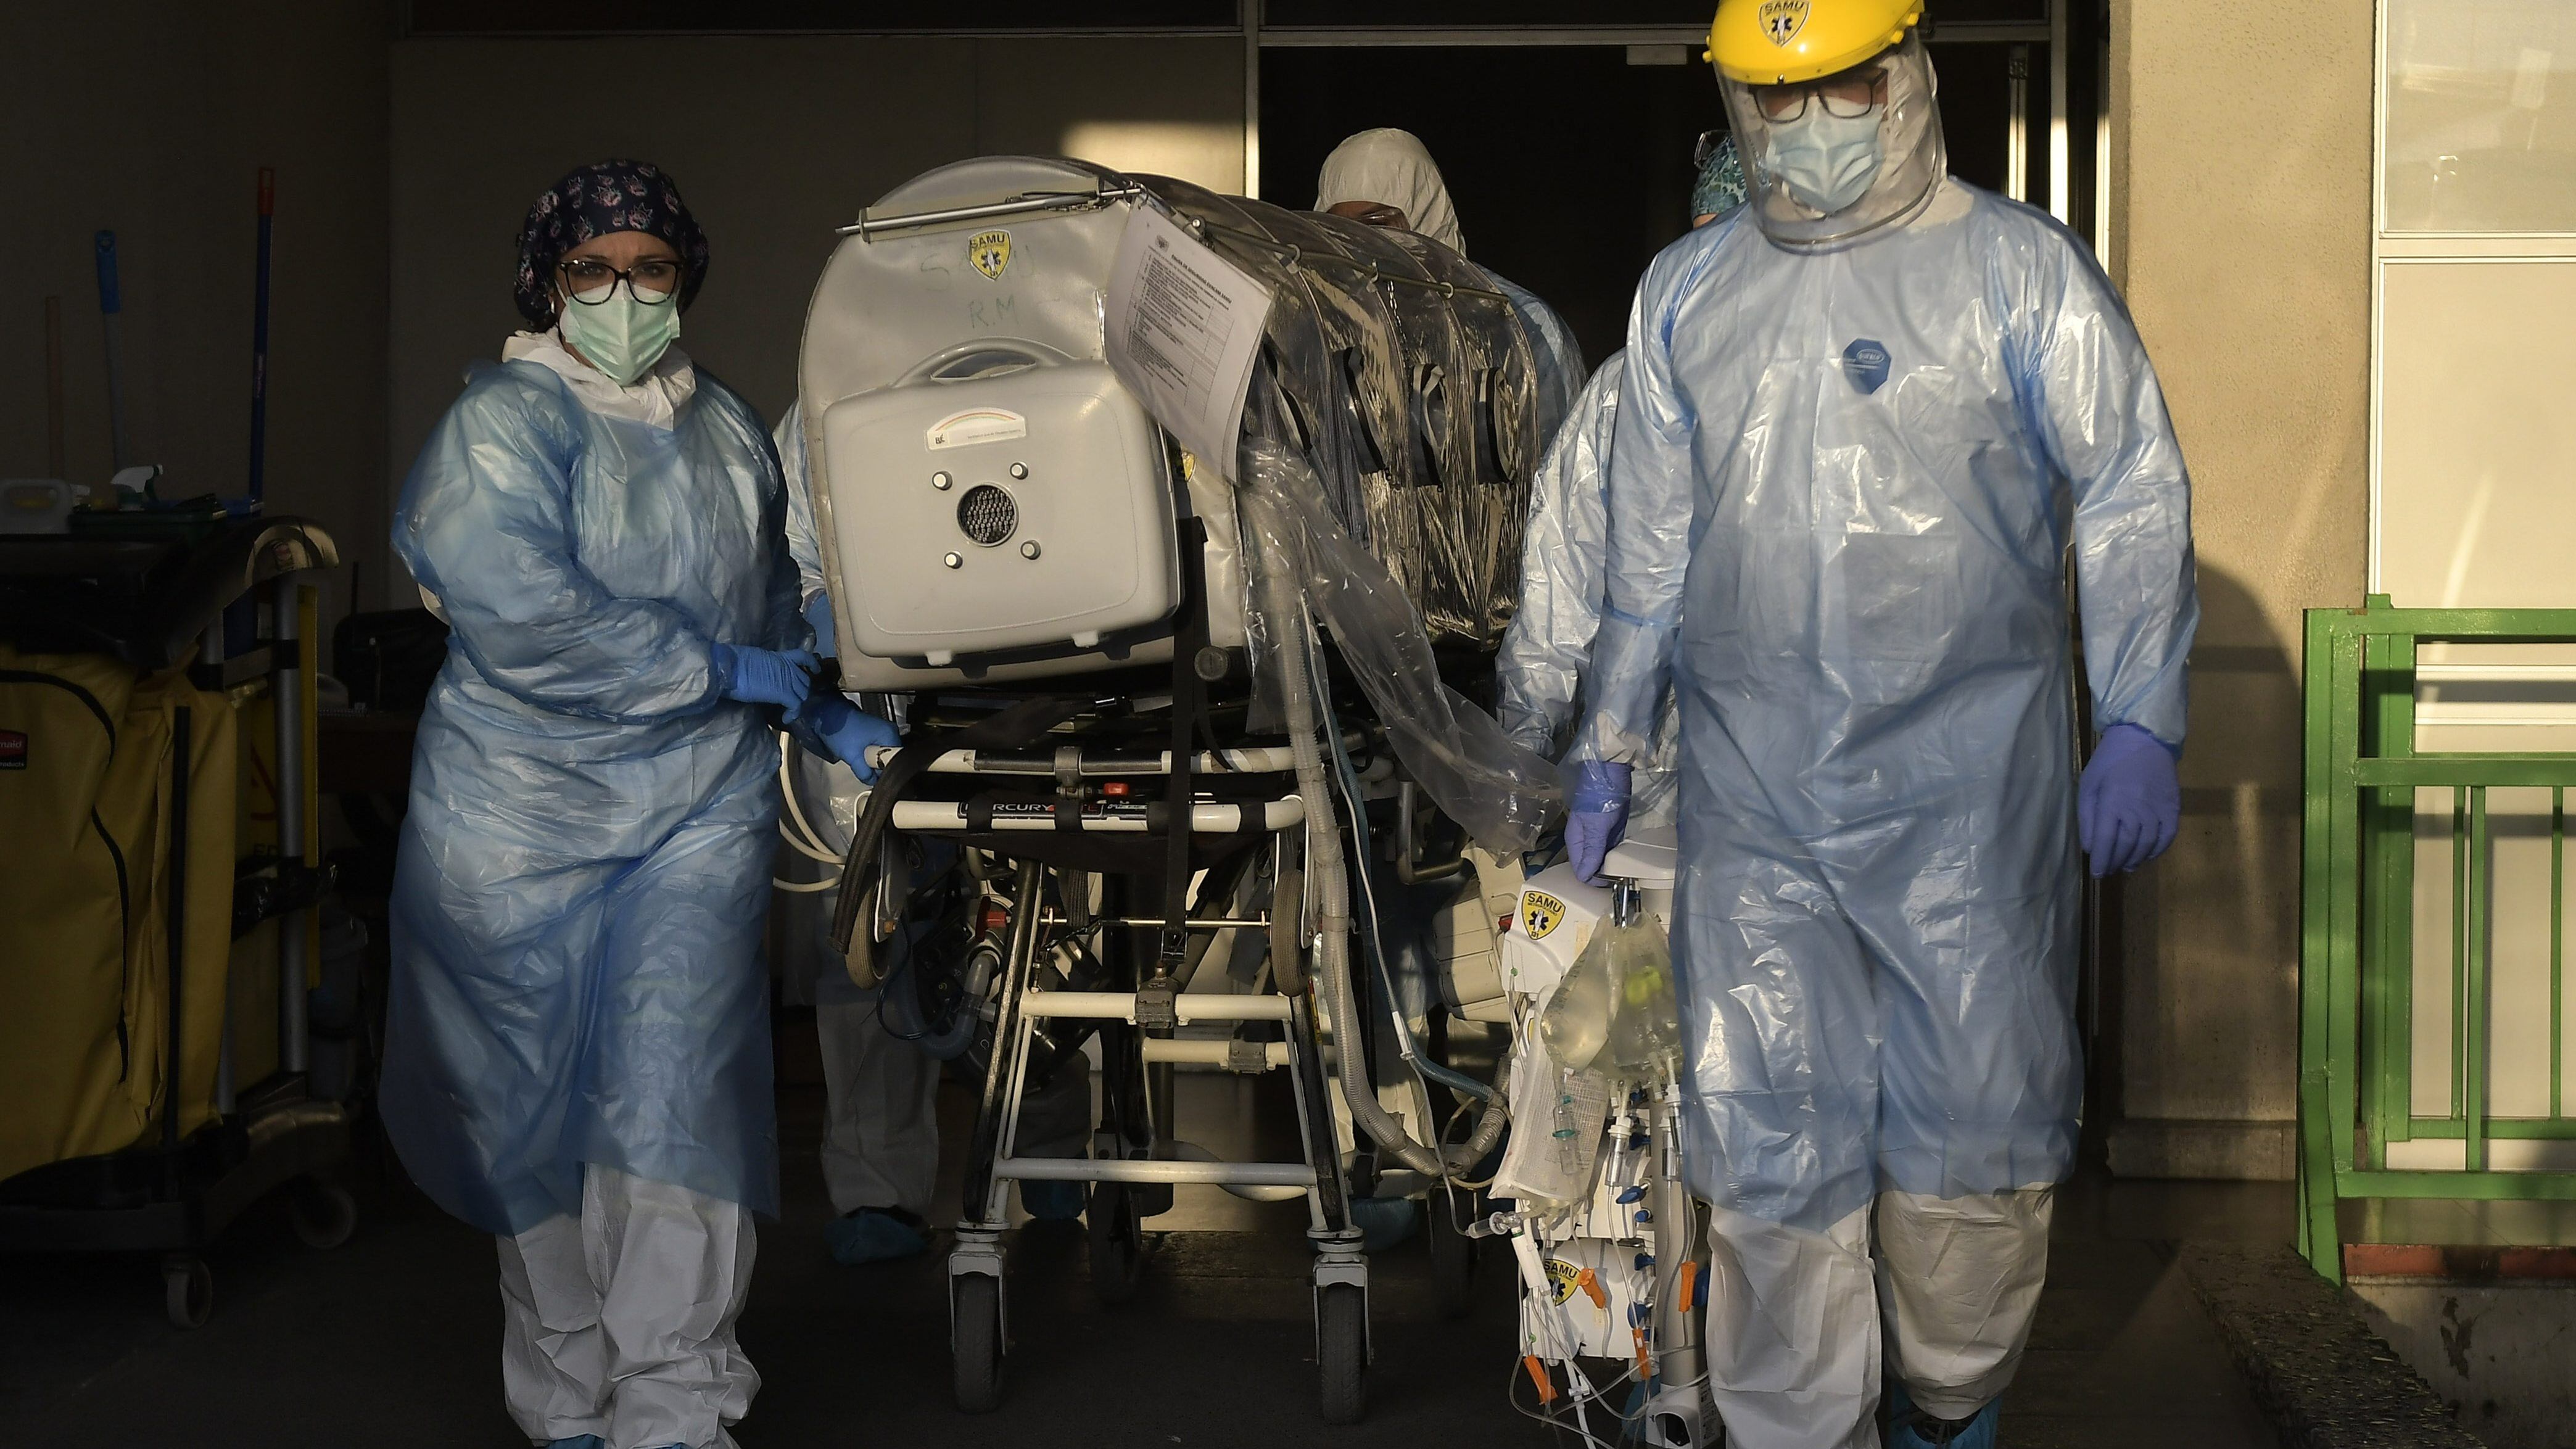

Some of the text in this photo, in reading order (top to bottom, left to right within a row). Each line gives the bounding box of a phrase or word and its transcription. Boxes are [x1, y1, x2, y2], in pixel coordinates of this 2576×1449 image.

[1765, 1, 1804, 15] SAMU
[970, 234, 1005, 249] SAMU
[0, 740, 21, 748] maid
[965, 803, 1054, 811] RCURY
[1527, 893, 1563, 912] SAMU
[1544, 1261, 1577, 1278] SAMU
